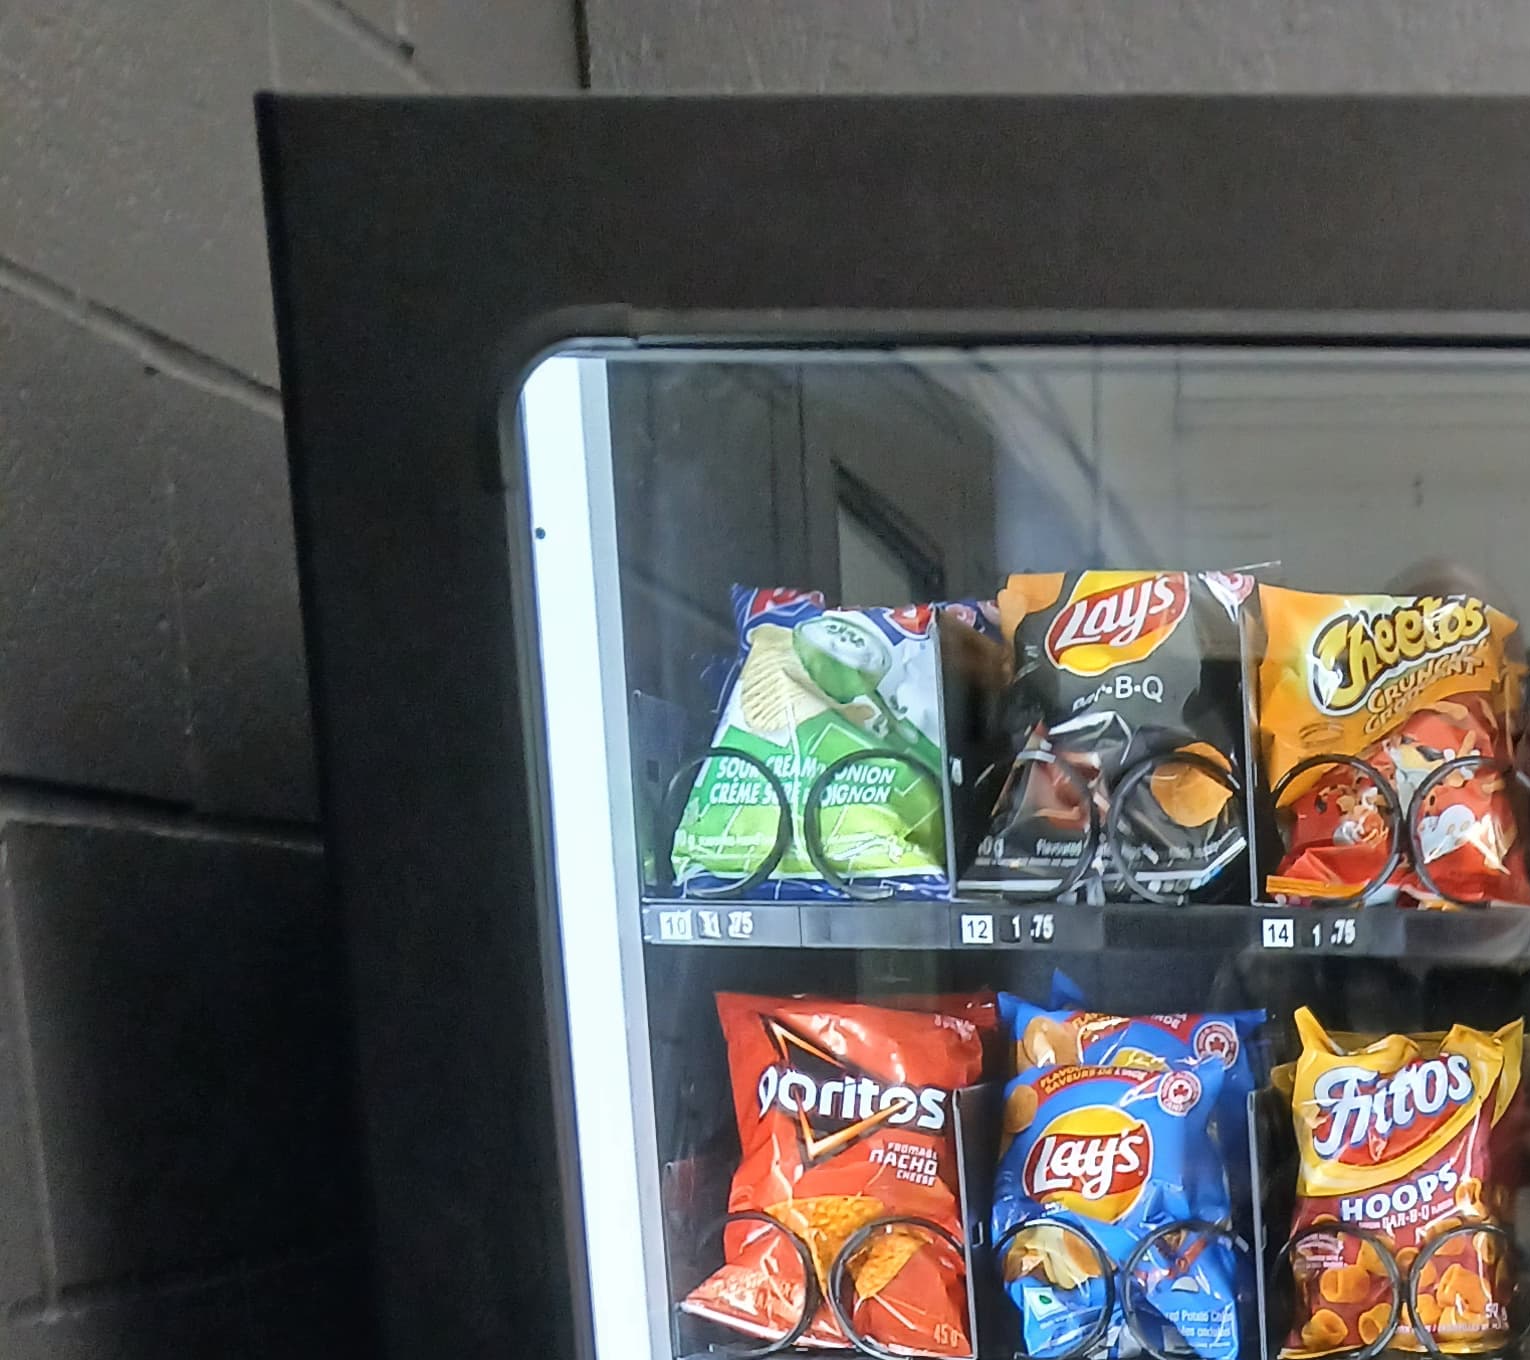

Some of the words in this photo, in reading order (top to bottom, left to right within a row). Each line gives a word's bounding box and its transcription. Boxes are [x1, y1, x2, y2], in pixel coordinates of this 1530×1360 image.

[1054, 573, 1176, 647] Lay's
[1316, 595, 1485, 708] Cheetos
[967, 919, 989, 939] 12
[1268, 923, 1289, 943] 14
[758, 1065, 947, 1130] Doritos
[1312, 1055, 1474, 1157] Fritos
[869, 1149, 938, 1176] NACHO
[896, 1169, 936, 1187] CHEESE
[1033, 1127, 1144, 1200] Lay's
[1340, 1163, 1458, 1222] HOOPS
